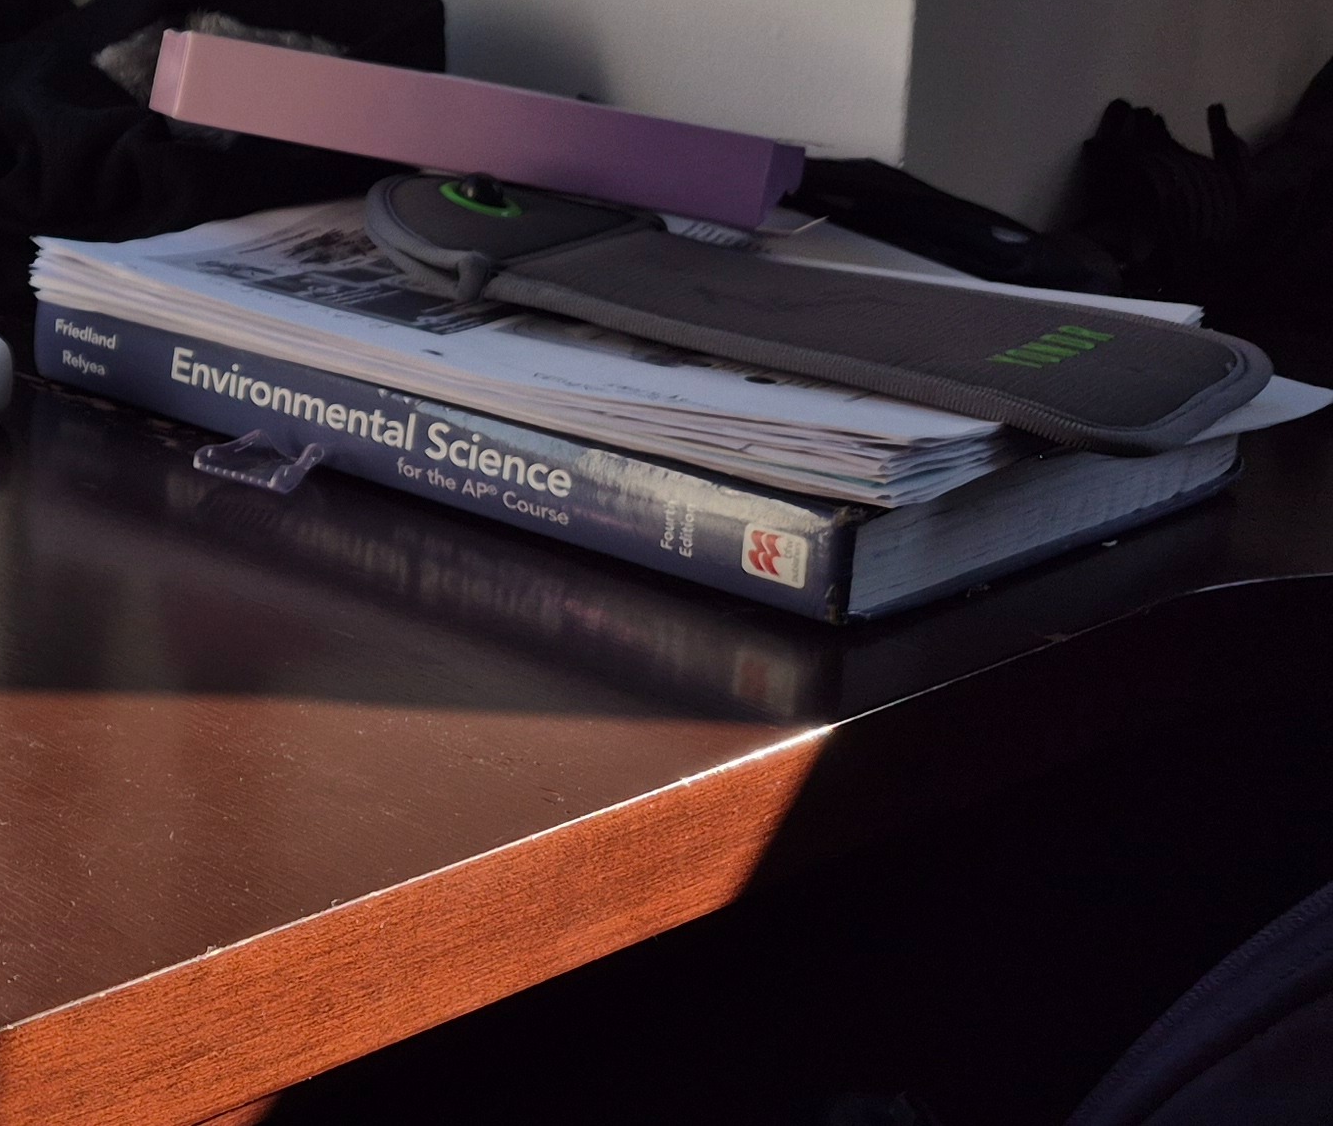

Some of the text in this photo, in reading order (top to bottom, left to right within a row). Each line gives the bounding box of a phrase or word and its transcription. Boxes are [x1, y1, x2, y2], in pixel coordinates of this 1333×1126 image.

[54, 318, 117, 350] Friedland
[62, 349, 106, 376] Relyea
[170, 346, 573, 498] Environmental Science
[396, 457, 423, 480] for
[426, 469, 457, 491] the
[502, 490, 569, 526] Course
[659, 499, 677, 551] Fourth
[678, 502, 697, 559] Edition
